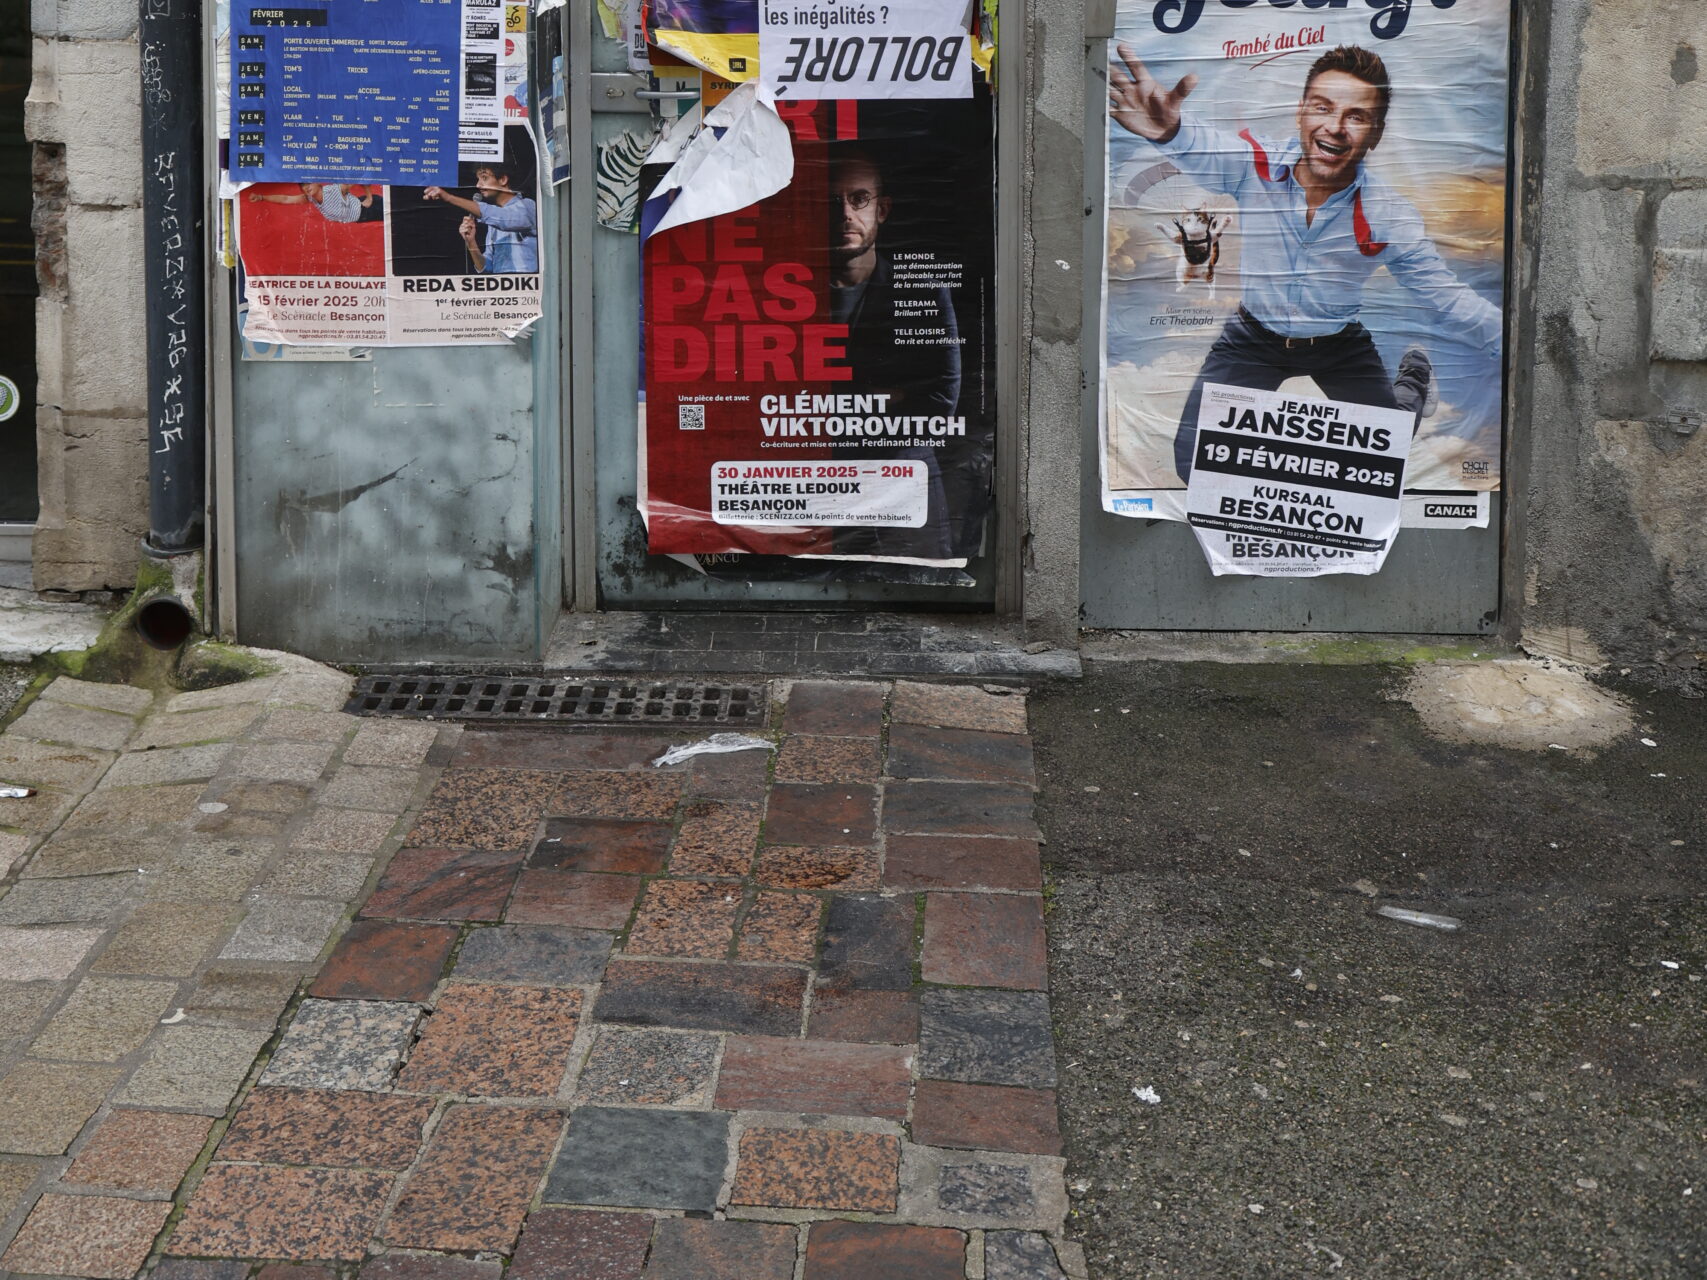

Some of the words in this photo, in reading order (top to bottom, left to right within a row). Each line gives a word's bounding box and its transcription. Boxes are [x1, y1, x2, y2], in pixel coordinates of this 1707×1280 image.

[252, 9, 284, 18] FÉVRIER
[764, 6, 789, 26] les
[793, 5, 876, 30] inégalités
[1222, 33, 1271, 59] Tombé
[1274, 32, 1295, 50] du
[1297, 25, 1325, 47] Ciel
[775, 35, 965, 97] BOLLORÉ
[908, 262, 963, 270] démonstration
[893, 272, 935, 280] implacable
[299, 280, 315, 289] DE
[317, 280, 332, 289] LA
[334, 280, 386, 290] BOULAYE
[403, 278, 456, 293] REDA
[461, 277, 539, 292] SEDDIKI
[893, 281, 903, 289] de
[904, 281, 911, 289] la
[912, 281, 962, 289] manipulation
[257, 295, 270, 306] 15
[275, 295, 320, 307] février
[323, 295, 359, 307] 2025
[363, 295, 386, 308] 20h
[435, 298, 448, 307] 1er
[450, 297, 487, 307] février
[490, 297, 519, 306] 2025
[521, 296, 539, 306] 20h
[652, 263, 818, 324] PAS
[330, 311, 385, 324] Besançon
[653, 324, 853, 384] DIRE
[697, 394, 715, 403] pièce
[716, 394, 724, 402] de
[760, 389, 891, 415] CLÉMENT
[1277, 400, 1340, 420] JEANFI
[760, 415, 966, 437] VIKTOROVITCH
[1218, 406, 1392, 451] JANSSENS
[760, 440, 800, 448] Co-écriture
[811, 440, 827, 448] mise
[838, 440, 859, 448] scène
[862, 438, 911, 447] Ferdinand
[913, 437, 946, 447] Barbet
[718, 466, 739, 479] 30
[742, 466, 812, 479] JANVIER
[816, 465, 858, 478] 2025
[881, 465, 914, 478] 20H
[1204, 442, 1231, 463] 19
[1236, 446, 1341, 480] FÉVRIER
[1344, 466, 1396, 487] 2025
[718, 480, 793, 495] THÉÂTRE
[796, 482, 861, 494] LEDOUX
[1253, 485, 1336, 510] KURSAAL
[718, 499, 807, 515] BESANÇON
[1426, 505, 1476, 517] CANAL+
[1219, 496, 1364, 535] BESANÇON
